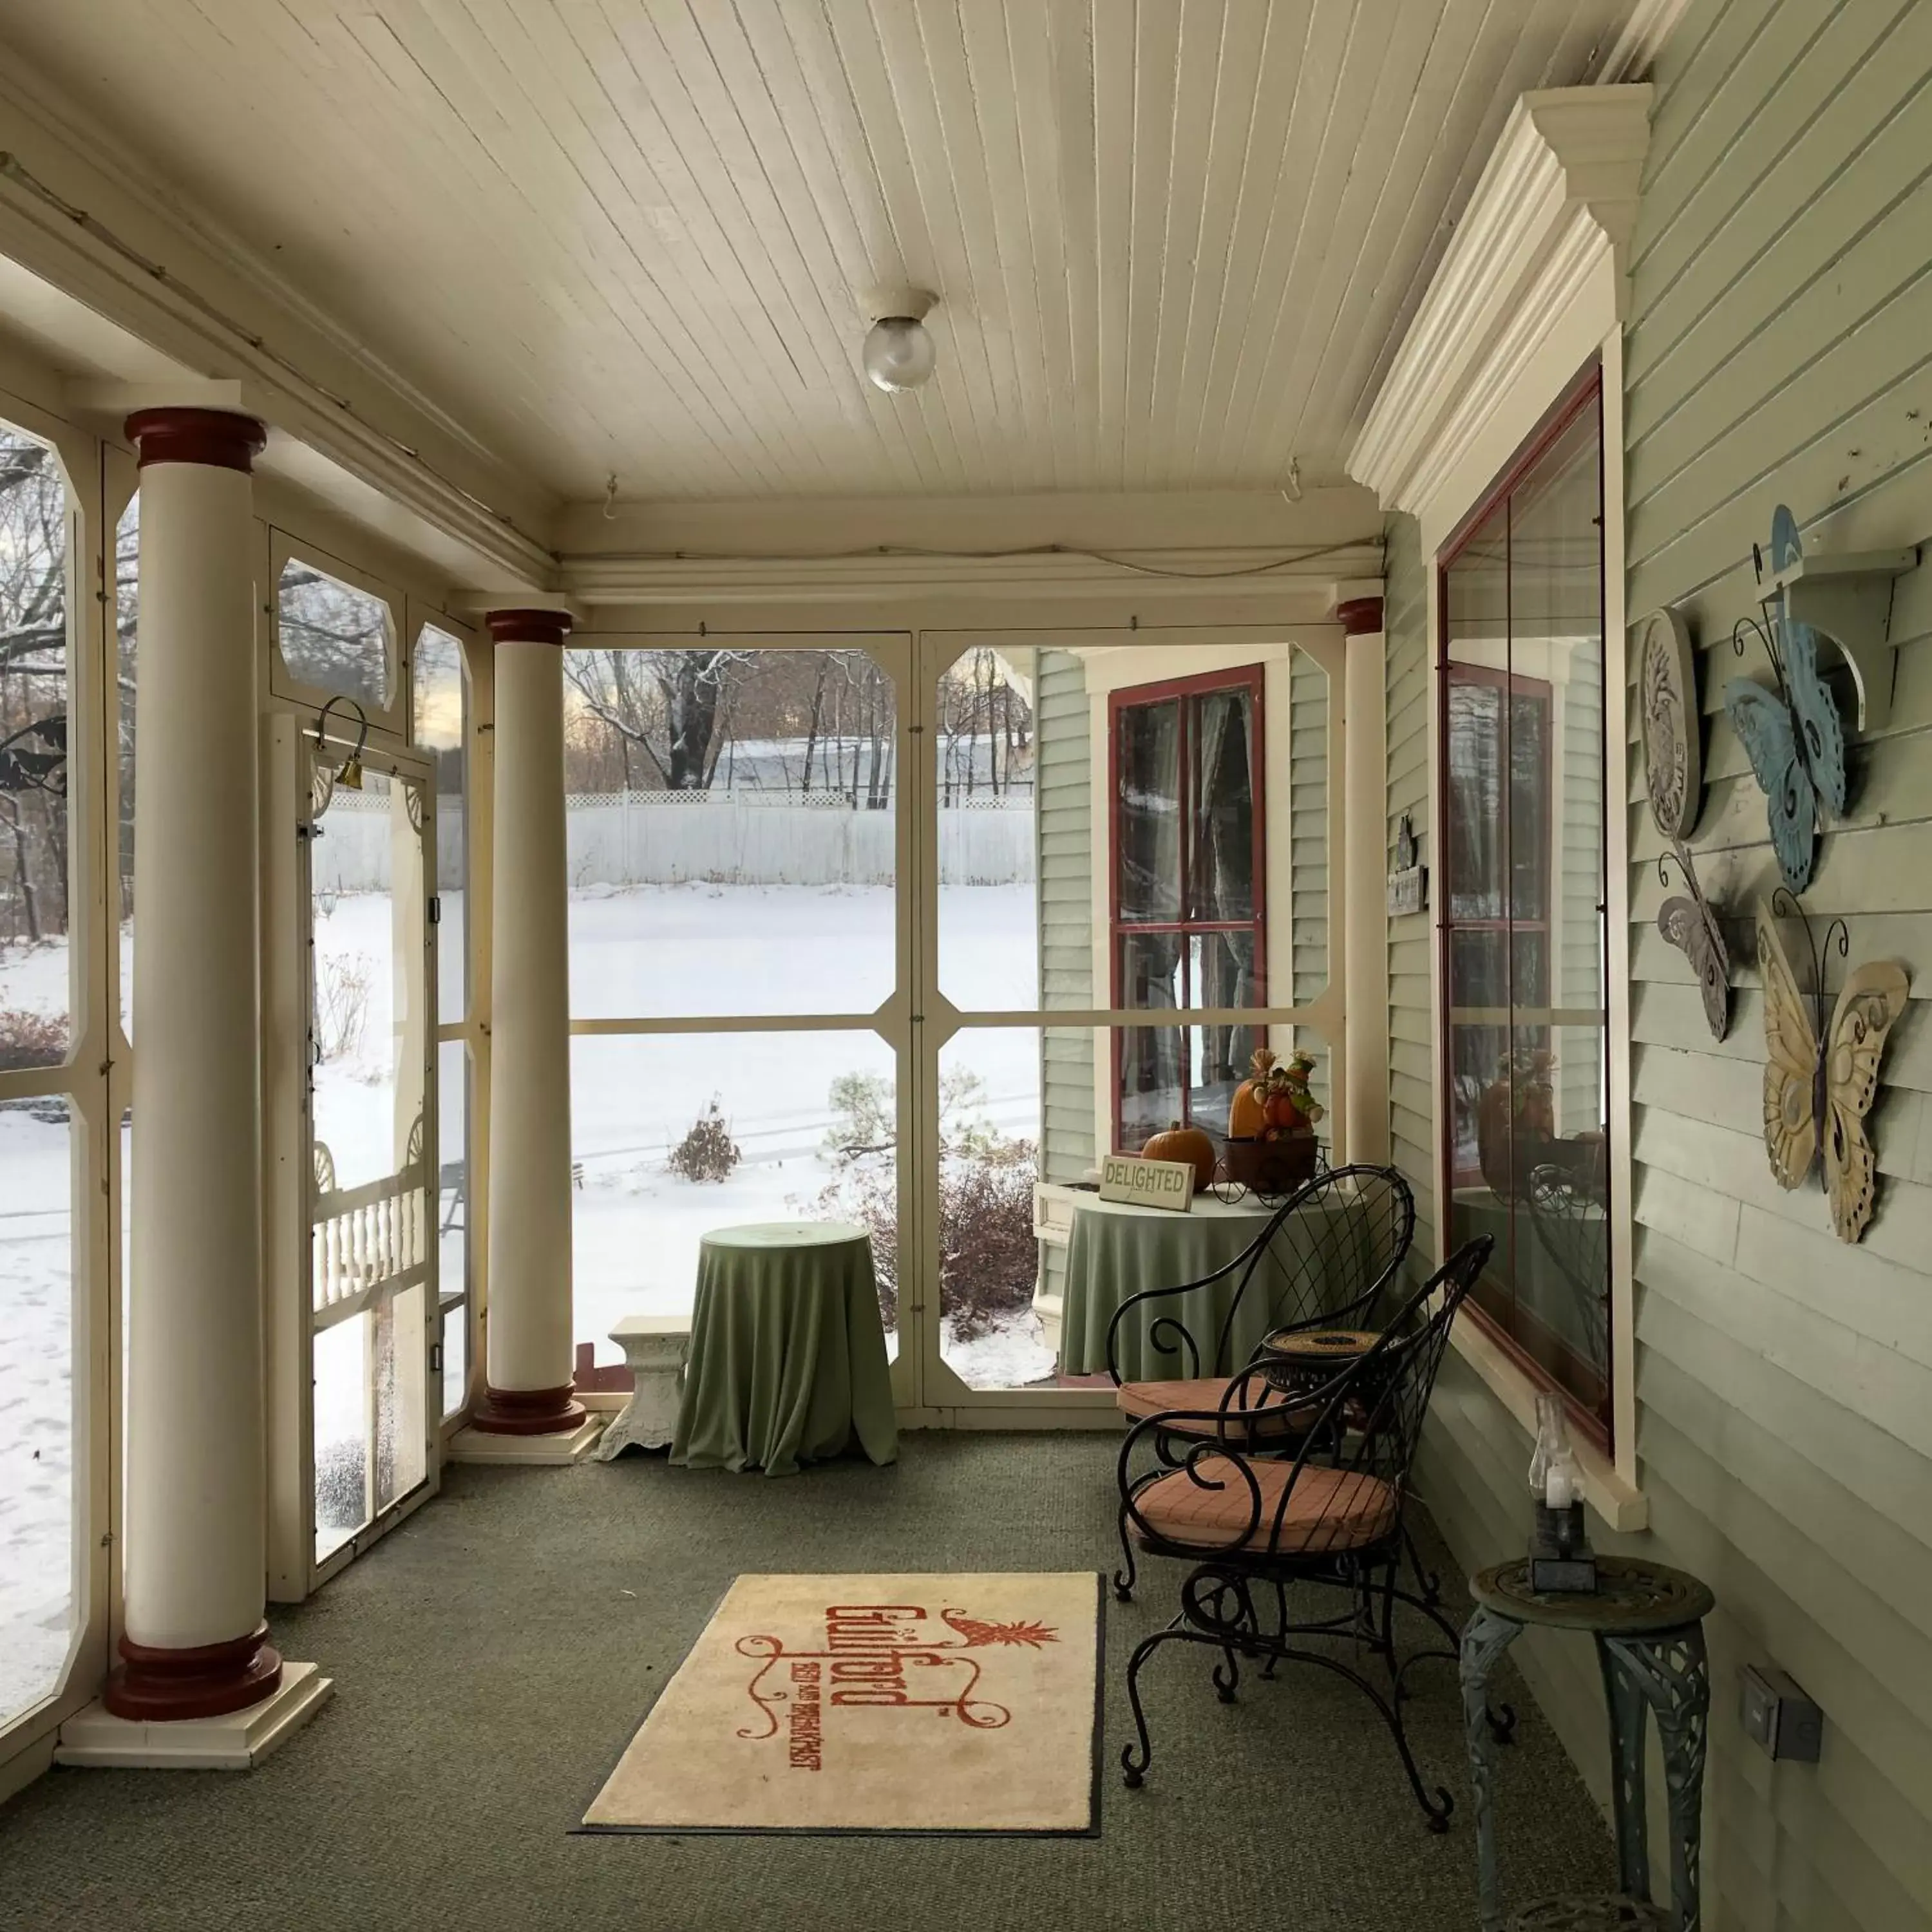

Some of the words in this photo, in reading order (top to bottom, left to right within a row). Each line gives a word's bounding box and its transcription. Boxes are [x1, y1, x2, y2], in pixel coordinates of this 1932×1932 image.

[1106, 1163, 1184, 1192] DELIGHTED
[779, 1605, 956, 1706] Guilford
[791, 1662, 821, 1682] BED
[796, 1685, 820, 1700] AND
[787, 1703, 823, 1770] BREAKFAST
